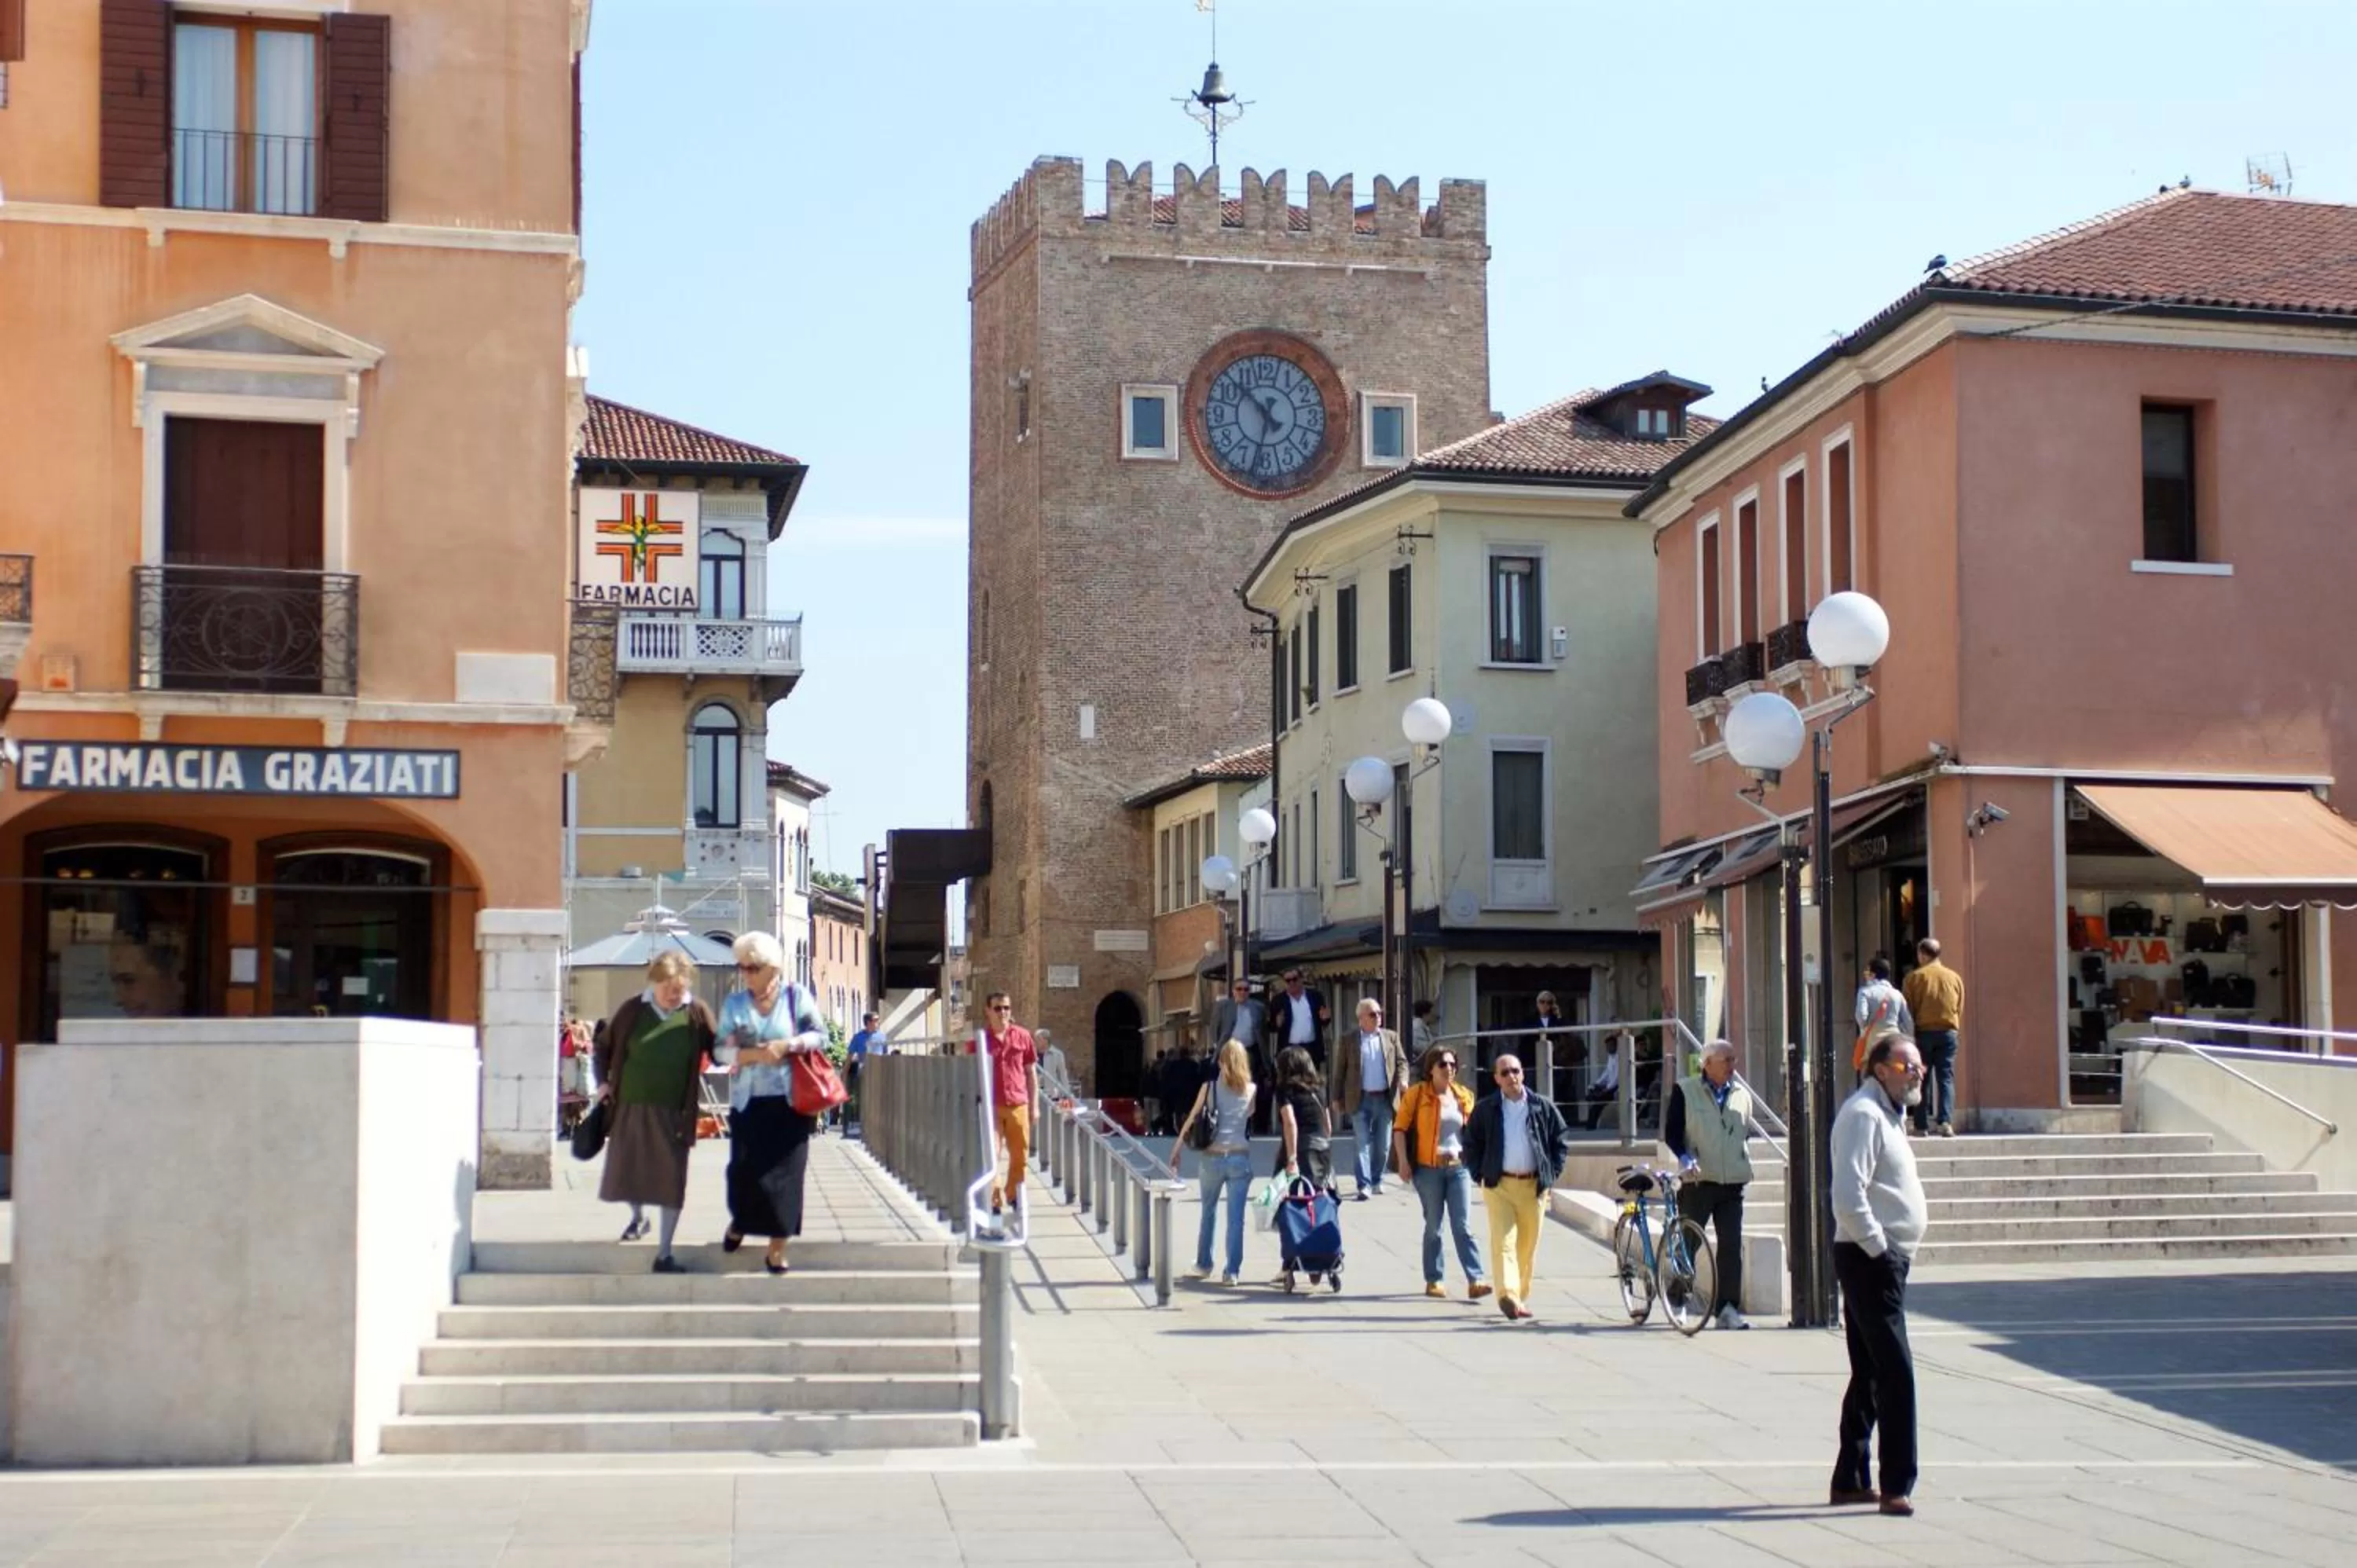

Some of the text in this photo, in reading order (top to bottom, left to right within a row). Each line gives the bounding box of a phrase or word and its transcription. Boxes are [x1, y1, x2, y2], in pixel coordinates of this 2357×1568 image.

[1238, 367, 1252, 387] 11
[1258, 361, 1274, 379] 12
[1284, 370, 1290, 388] 1
[1219, 382, 1237, 402] 10
[1299, 383, 1311, 403] 2
[1213, 405, 1224, 423] 9
[1307, 408, 1318, 427] 3
[1221, 428, 1232, 447] 8
[1299, 430, 1309, 450] 4
[1237, 445, 1248, 464] 7
[1259, 452, 1271, 470] 6
[1281, 445, 1293, 466] 5
[581, 584, 695, 606] FARMACIA
[22, 746, 453, 793] FARMACIA GRAZIATI
